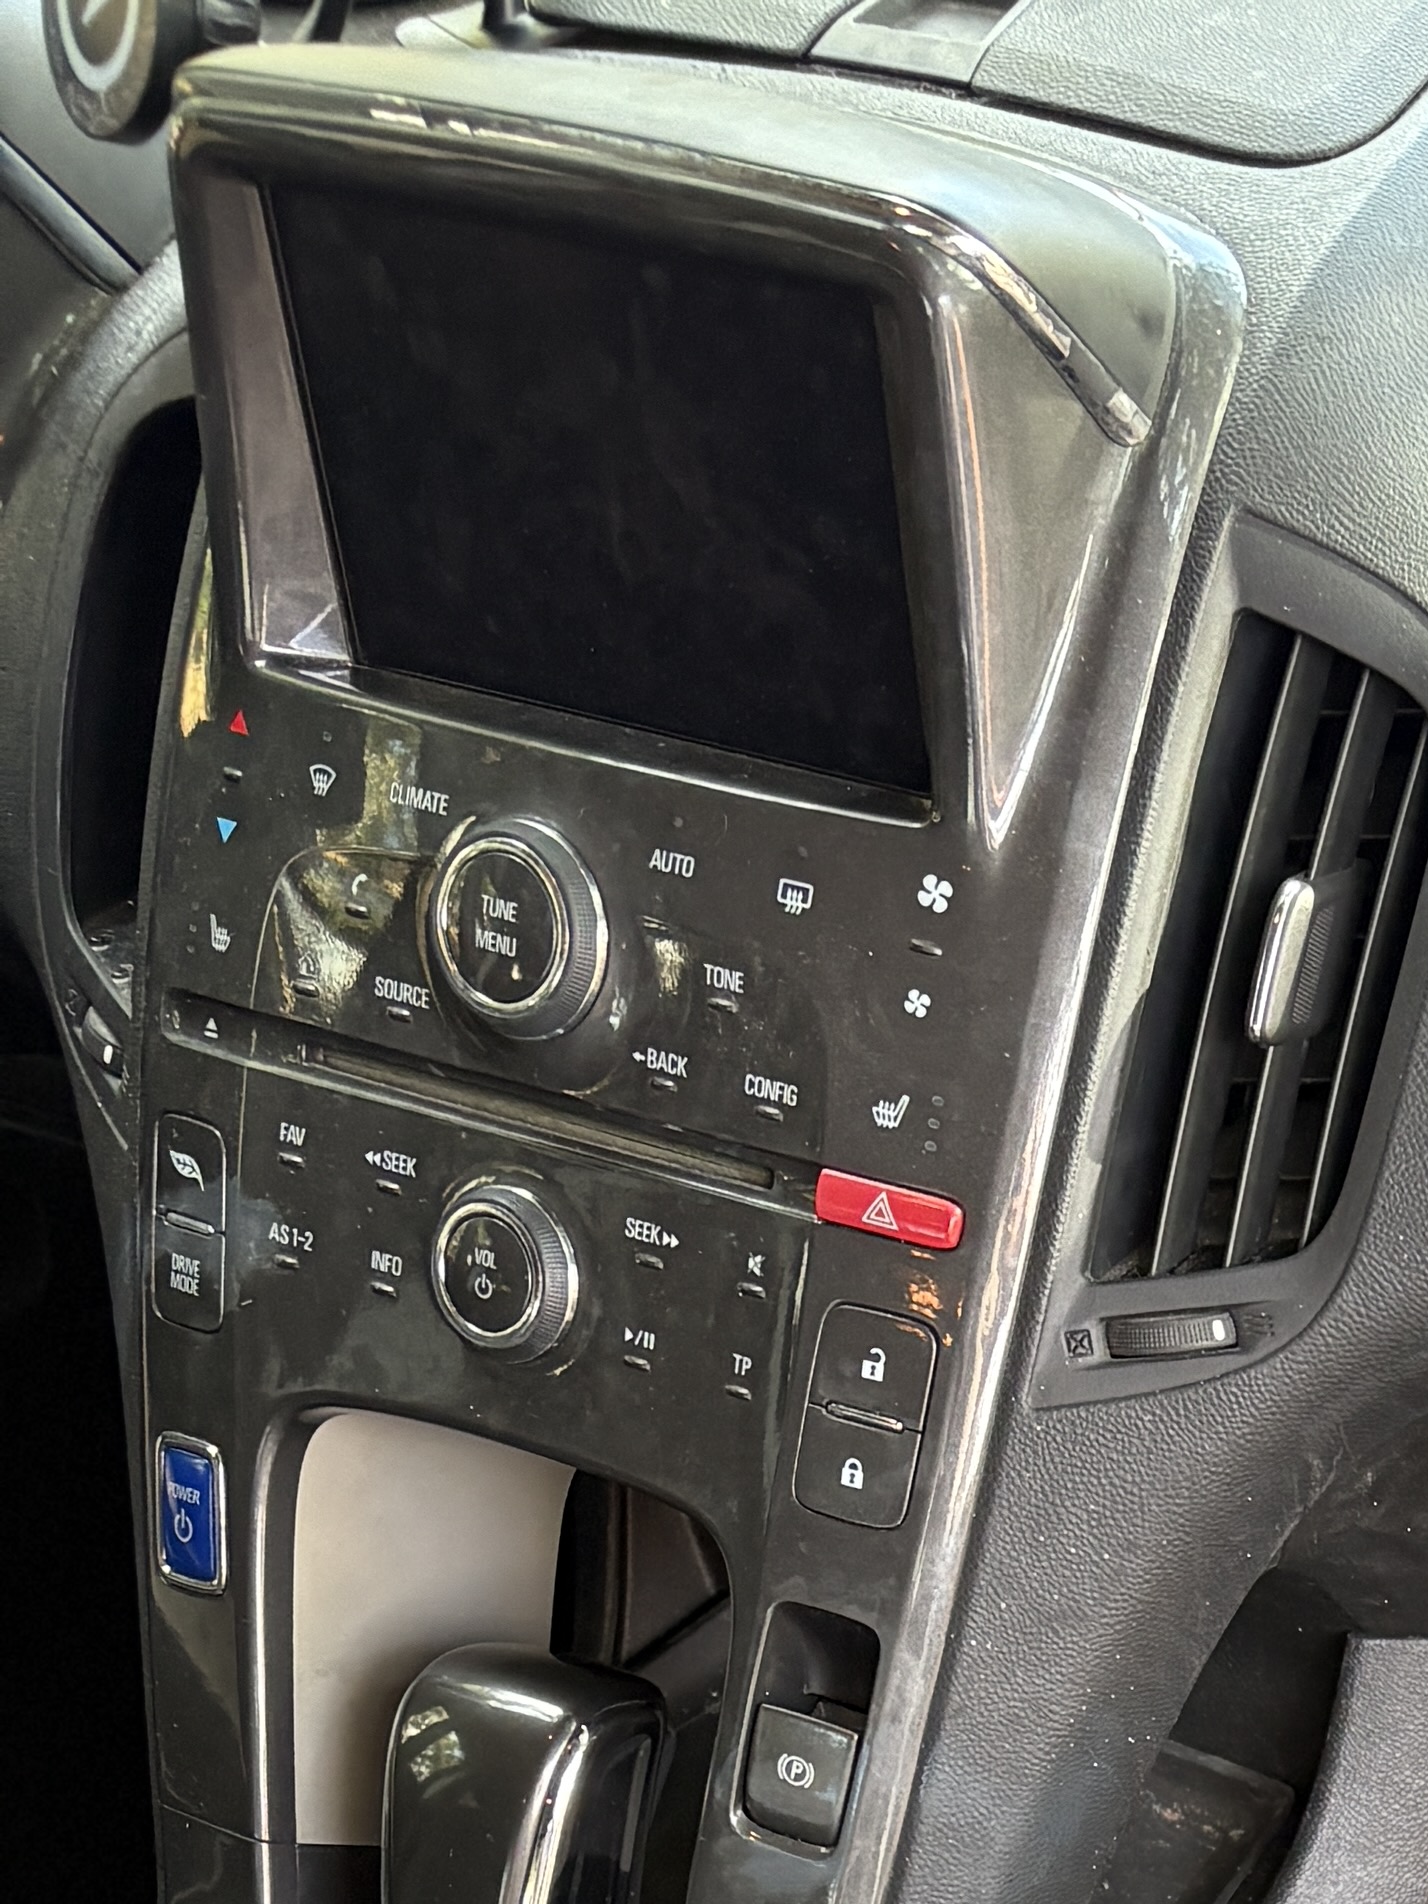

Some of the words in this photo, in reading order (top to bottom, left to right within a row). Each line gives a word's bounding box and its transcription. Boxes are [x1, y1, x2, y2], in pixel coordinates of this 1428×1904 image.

[389, 781, 449, 816] CLIMATE
[649, 848, 695, 878] AUTO
[480, 894, 519, 923] TUNE
[475, 928, 517, 958] MENU
[374, 975, 430, 1010] SOURCE
[703, 962, 744, 995] TONE
[646, 1047, 688, 1079] BACK
[744, 1073, 798, 1107] CONFIG
[279, 1122, 306, 1147] FAV
[383, 1149, 417, 1178] SEEK
[268, 1223, 289, 1247] AS
[291, 1227, 314, 1252] 1-2
[624, 1217, 662, 1246] SEEK
[171, 1253, 201, 1279] DRIVE
[371, 1250, 403, 1277] INFO
[474, 1246, 497, 1270] VOL
[170, 1272, 200, 1296] MODE
[733, 1353, 752, 1375] TP
[168, 1481, 201, 1507] POWER
